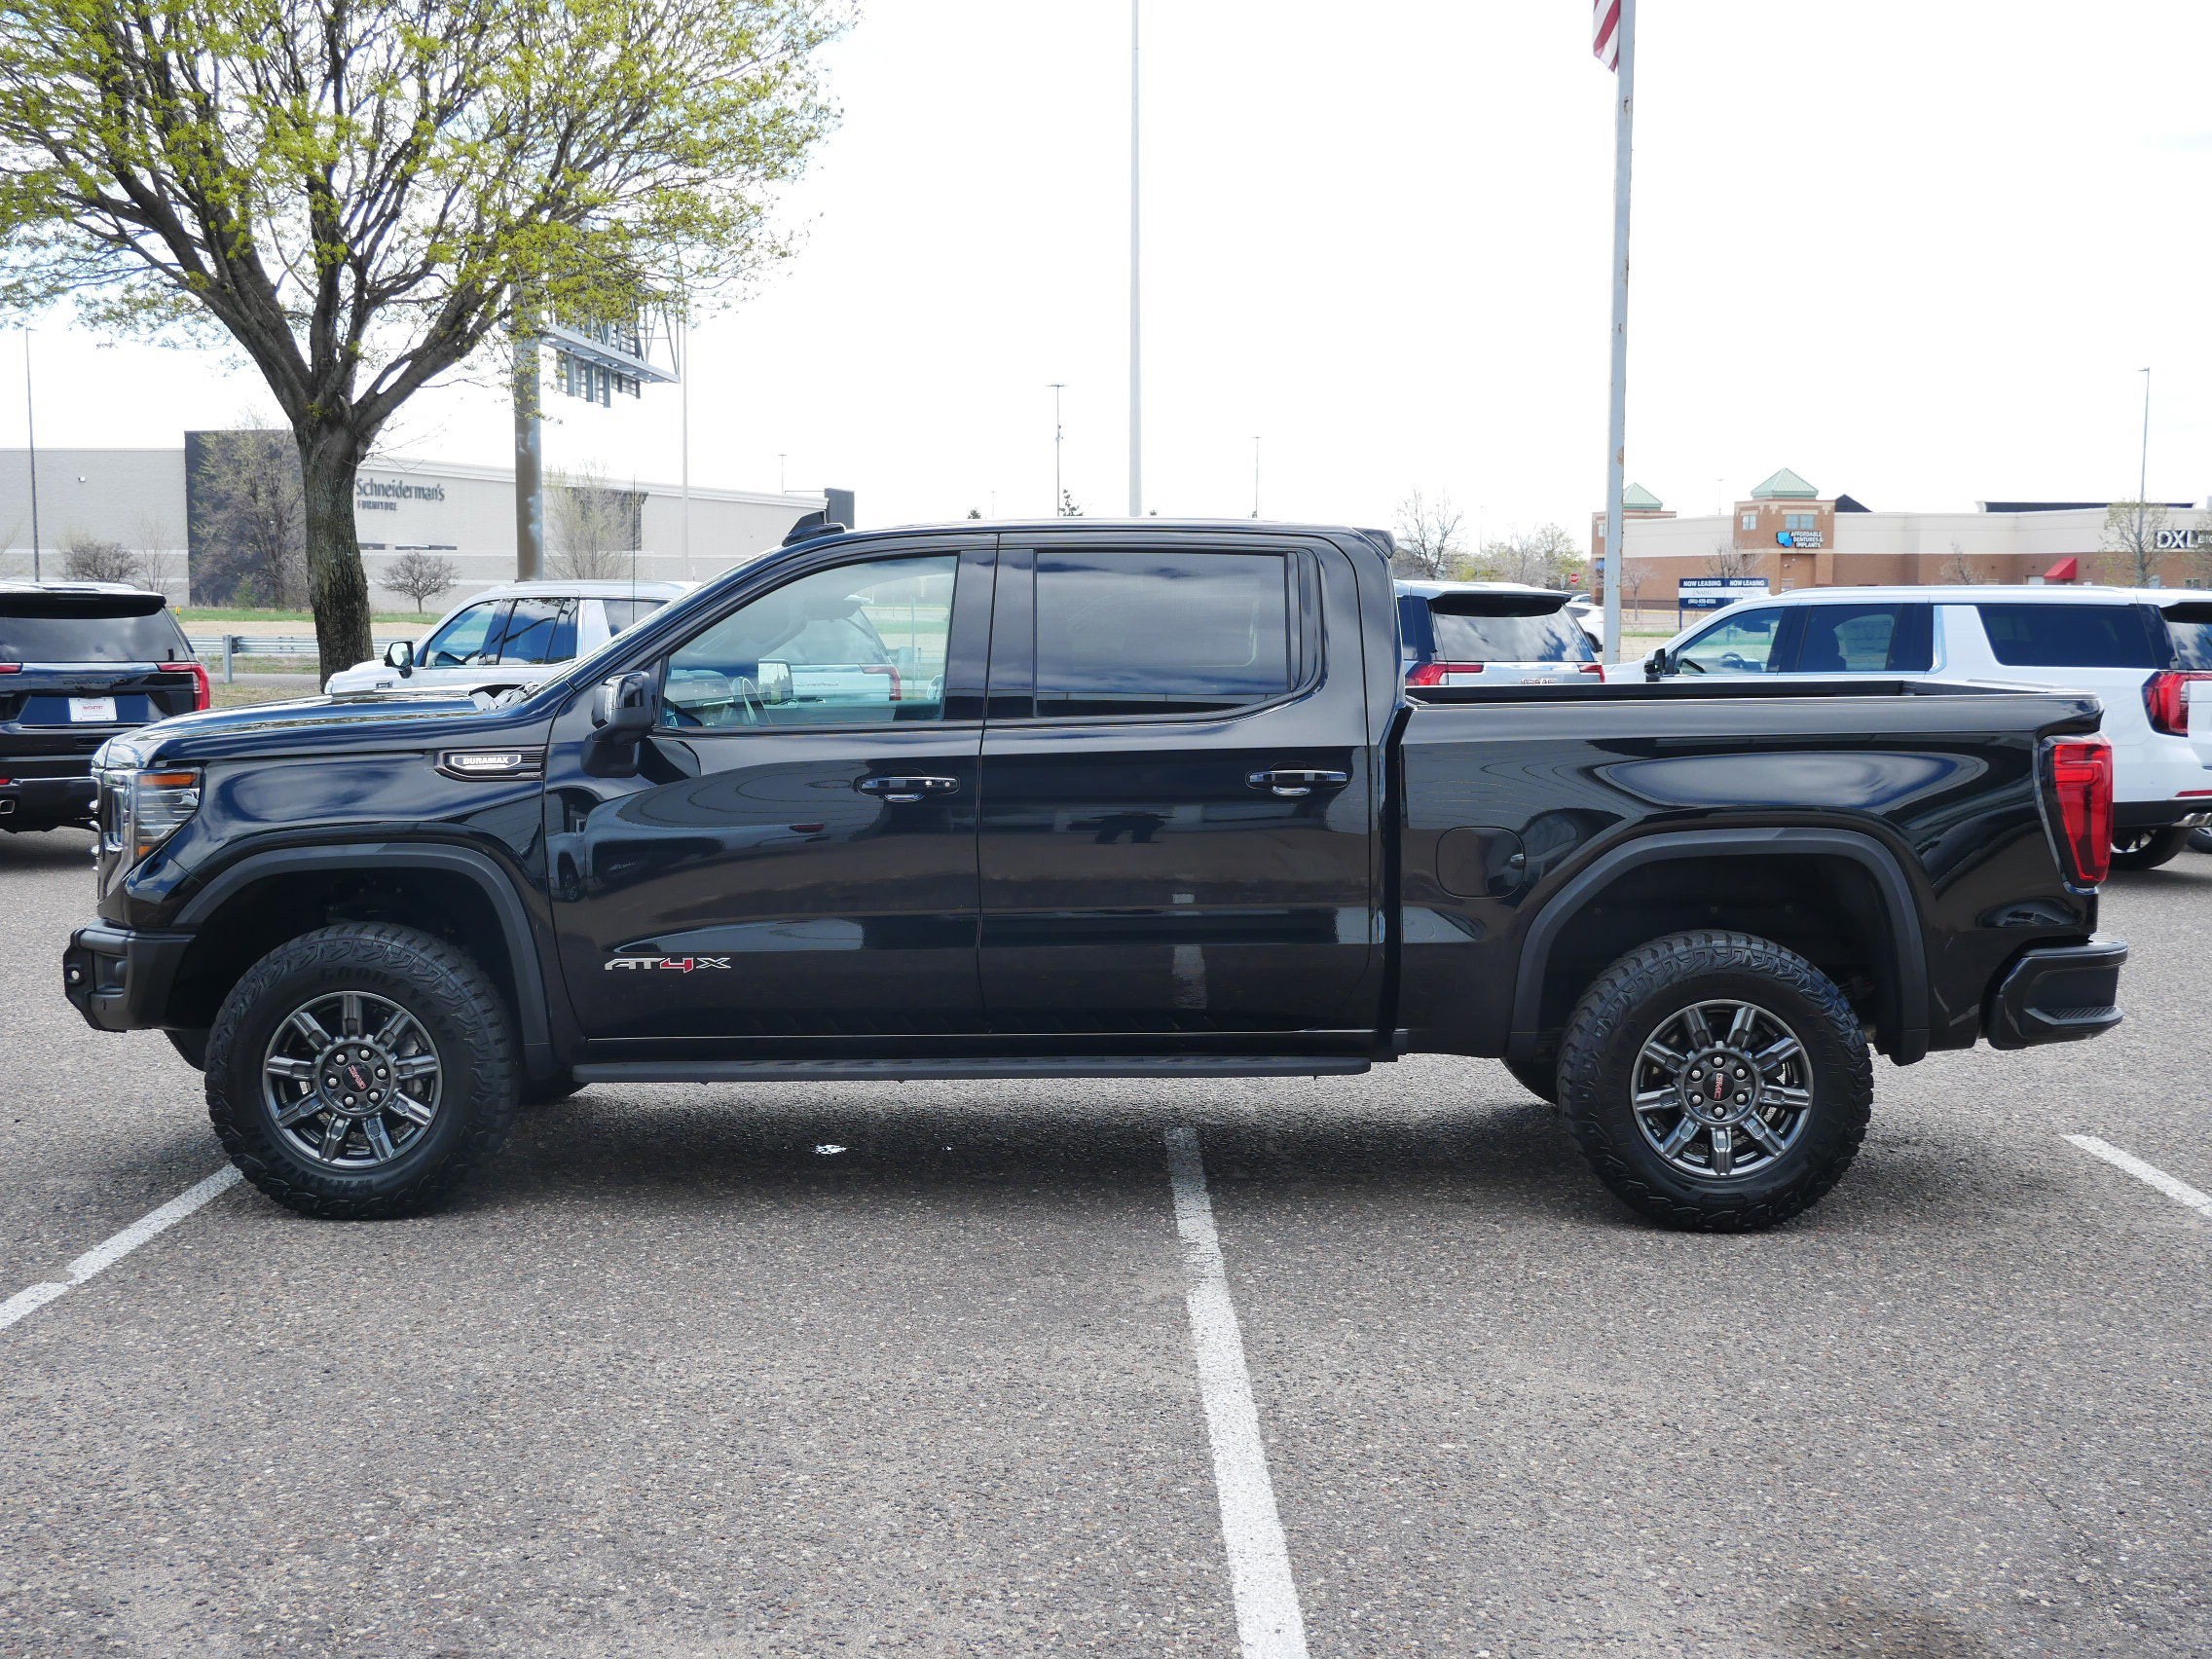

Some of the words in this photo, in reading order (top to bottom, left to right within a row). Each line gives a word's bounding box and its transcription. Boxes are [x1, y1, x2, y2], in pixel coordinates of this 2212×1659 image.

[356, 477, 445, 501] Schneiderman's
[357, 499, 397, 511] FURNITURE
[2157, 530, 2197, 548] DXL
[462, 756, 508, 765] DURAMAX
[605, 957, 731, 974] AT4X
[1714, 1072, 1724, 1100] GMC
